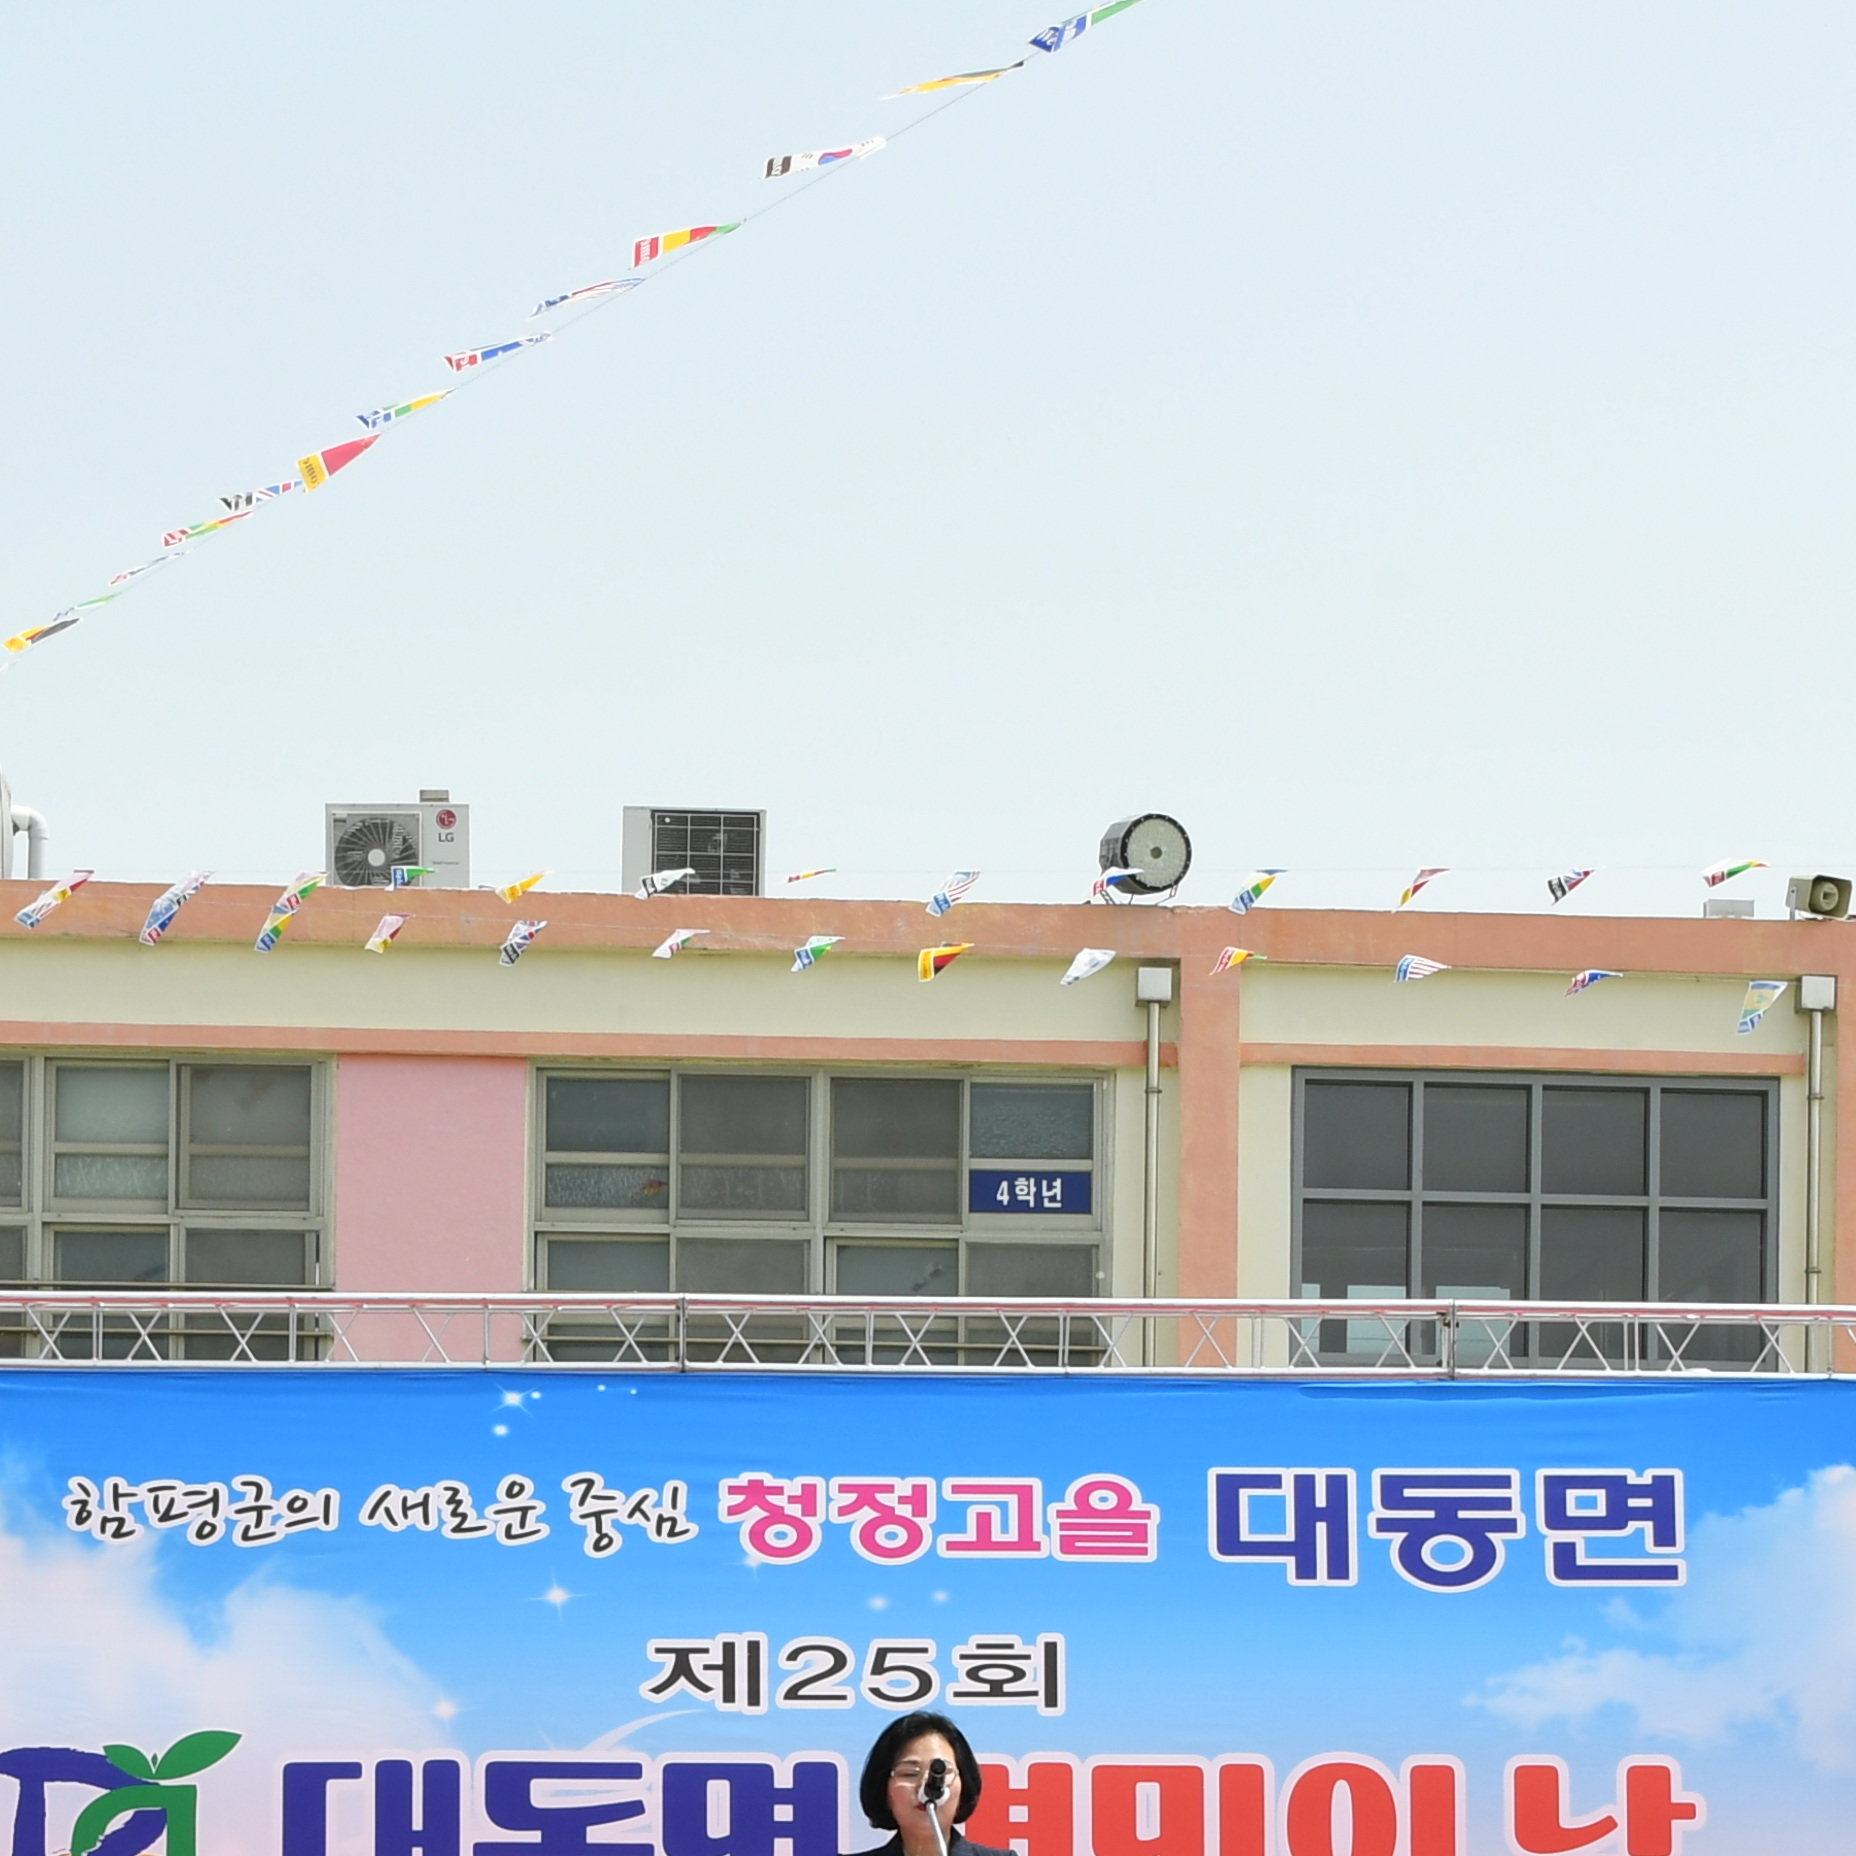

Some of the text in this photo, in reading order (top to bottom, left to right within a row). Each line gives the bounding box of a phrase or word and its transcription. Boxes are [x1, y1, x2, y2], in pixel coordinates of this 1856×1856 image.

[438, 833, 454, 842] LG
[996, 1177, 1062, 1208] 4학년
[68, 1471, 1681, 1587] 함평군의 새로운 중심 청정고을 대동면
[650, 1638, 1059, 1708] 제25회
